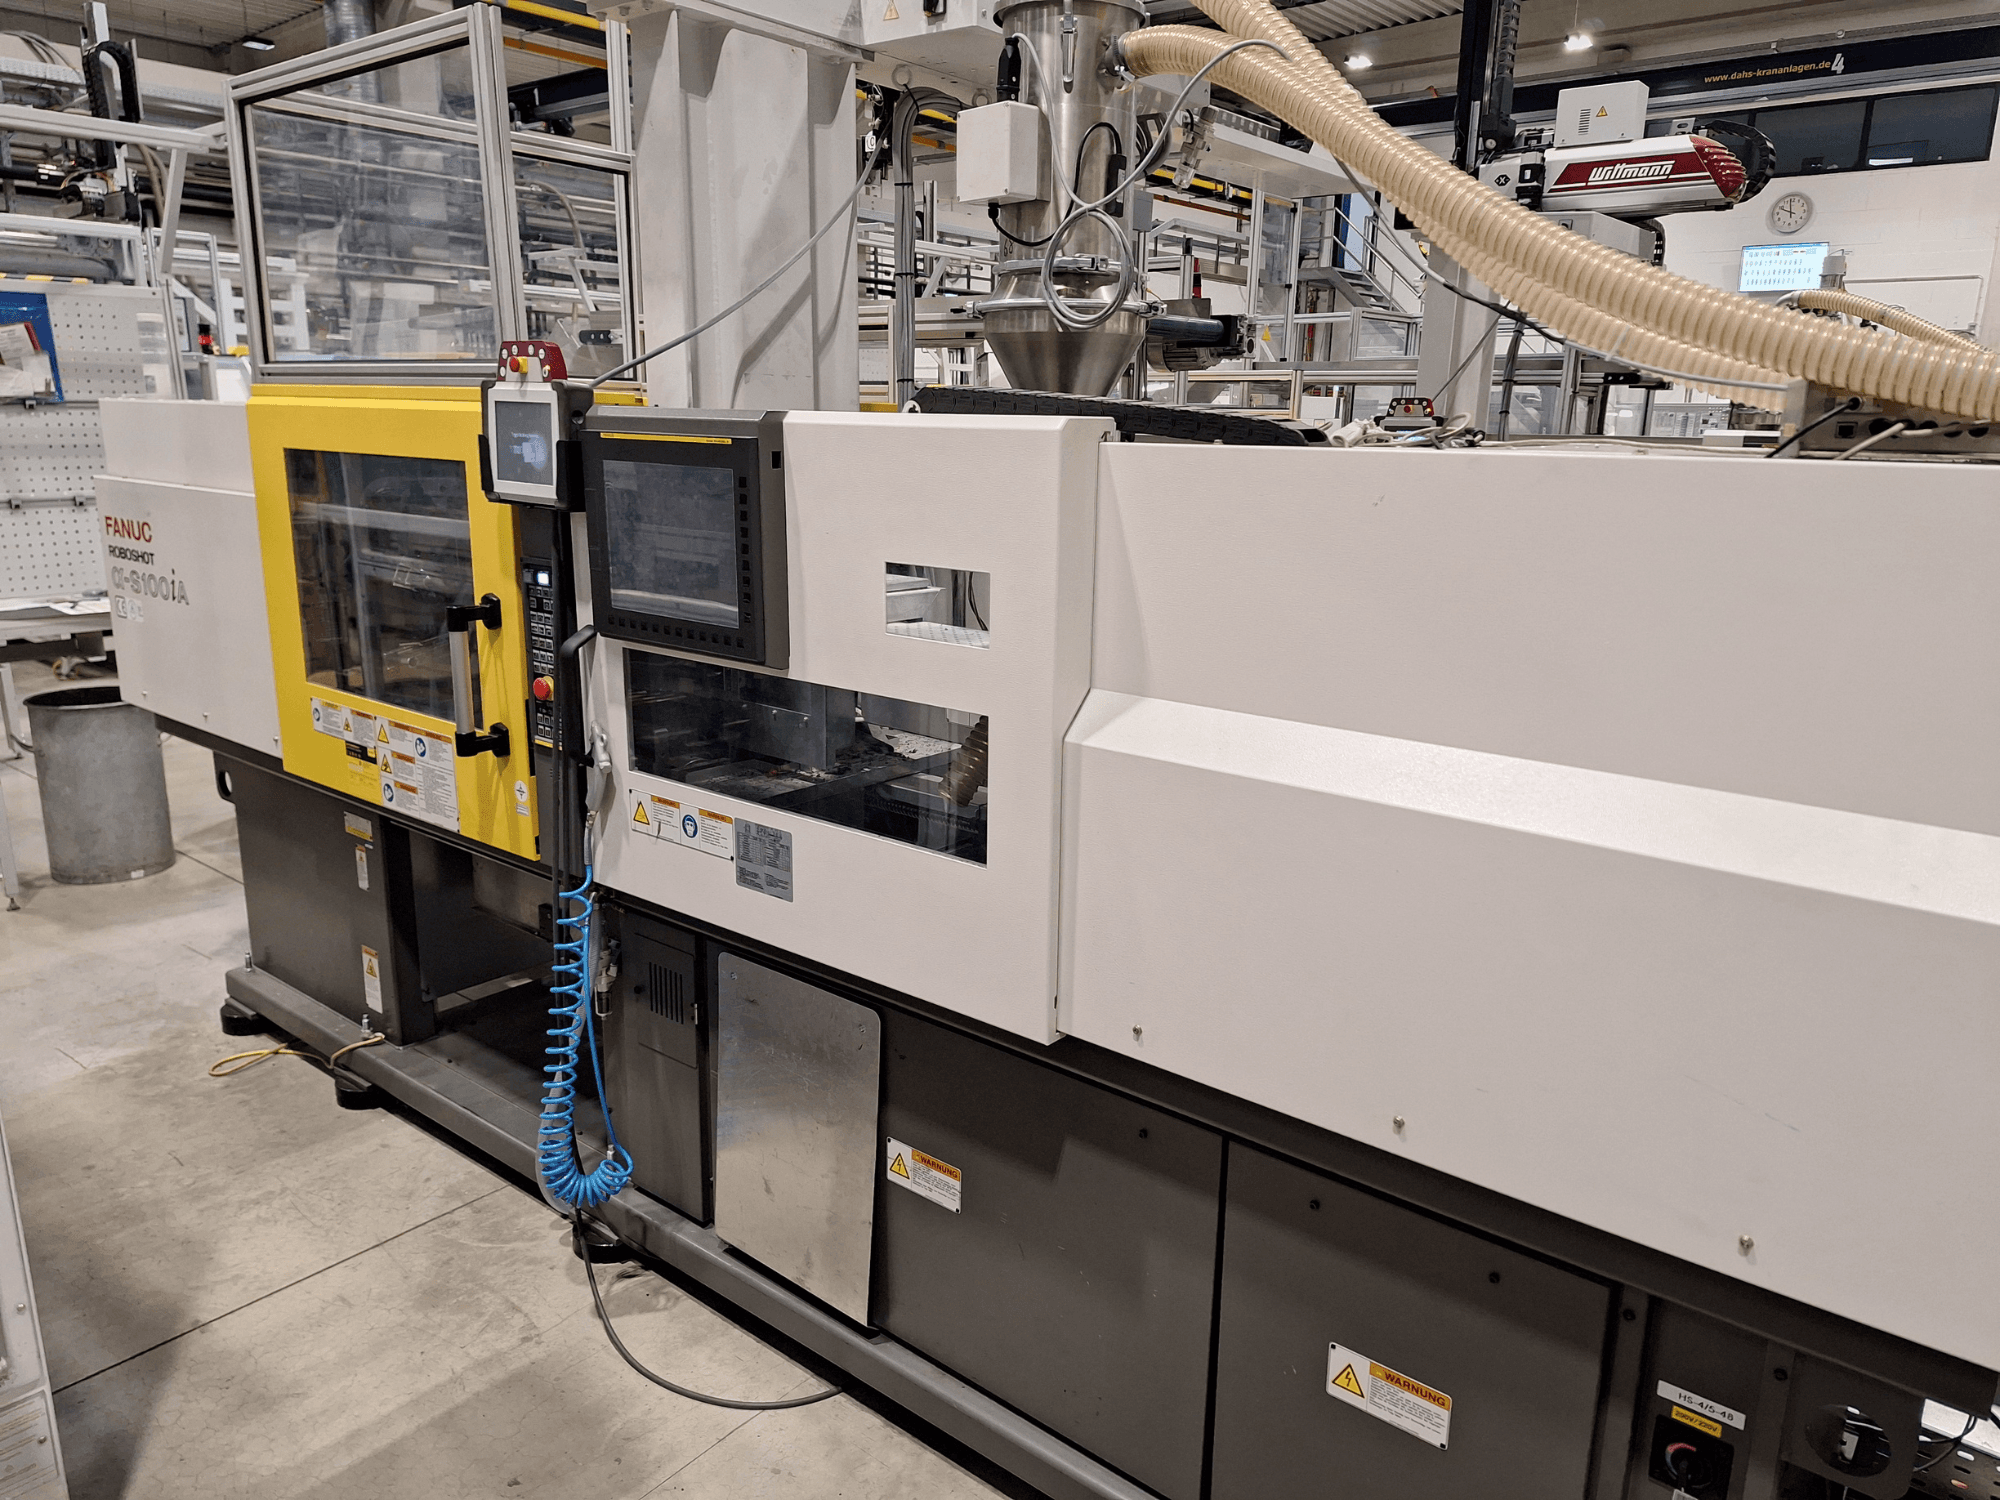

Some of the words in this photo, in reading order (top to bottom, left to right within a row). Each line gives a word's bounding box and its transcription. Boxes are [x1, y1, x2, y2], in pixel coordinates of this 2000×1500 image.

[1704, 60, 1832, 83] www.dahs-krananlagen.de
[1831, 53, 1845, 74] 4
[104, 515, 152, 543] FANUC
[108, 544, 155, 566] ROBOSHOT
[920, 1155, 958, 1178] WARNUNG
[1384, 1371, 1446, 1407] WARNUNG
